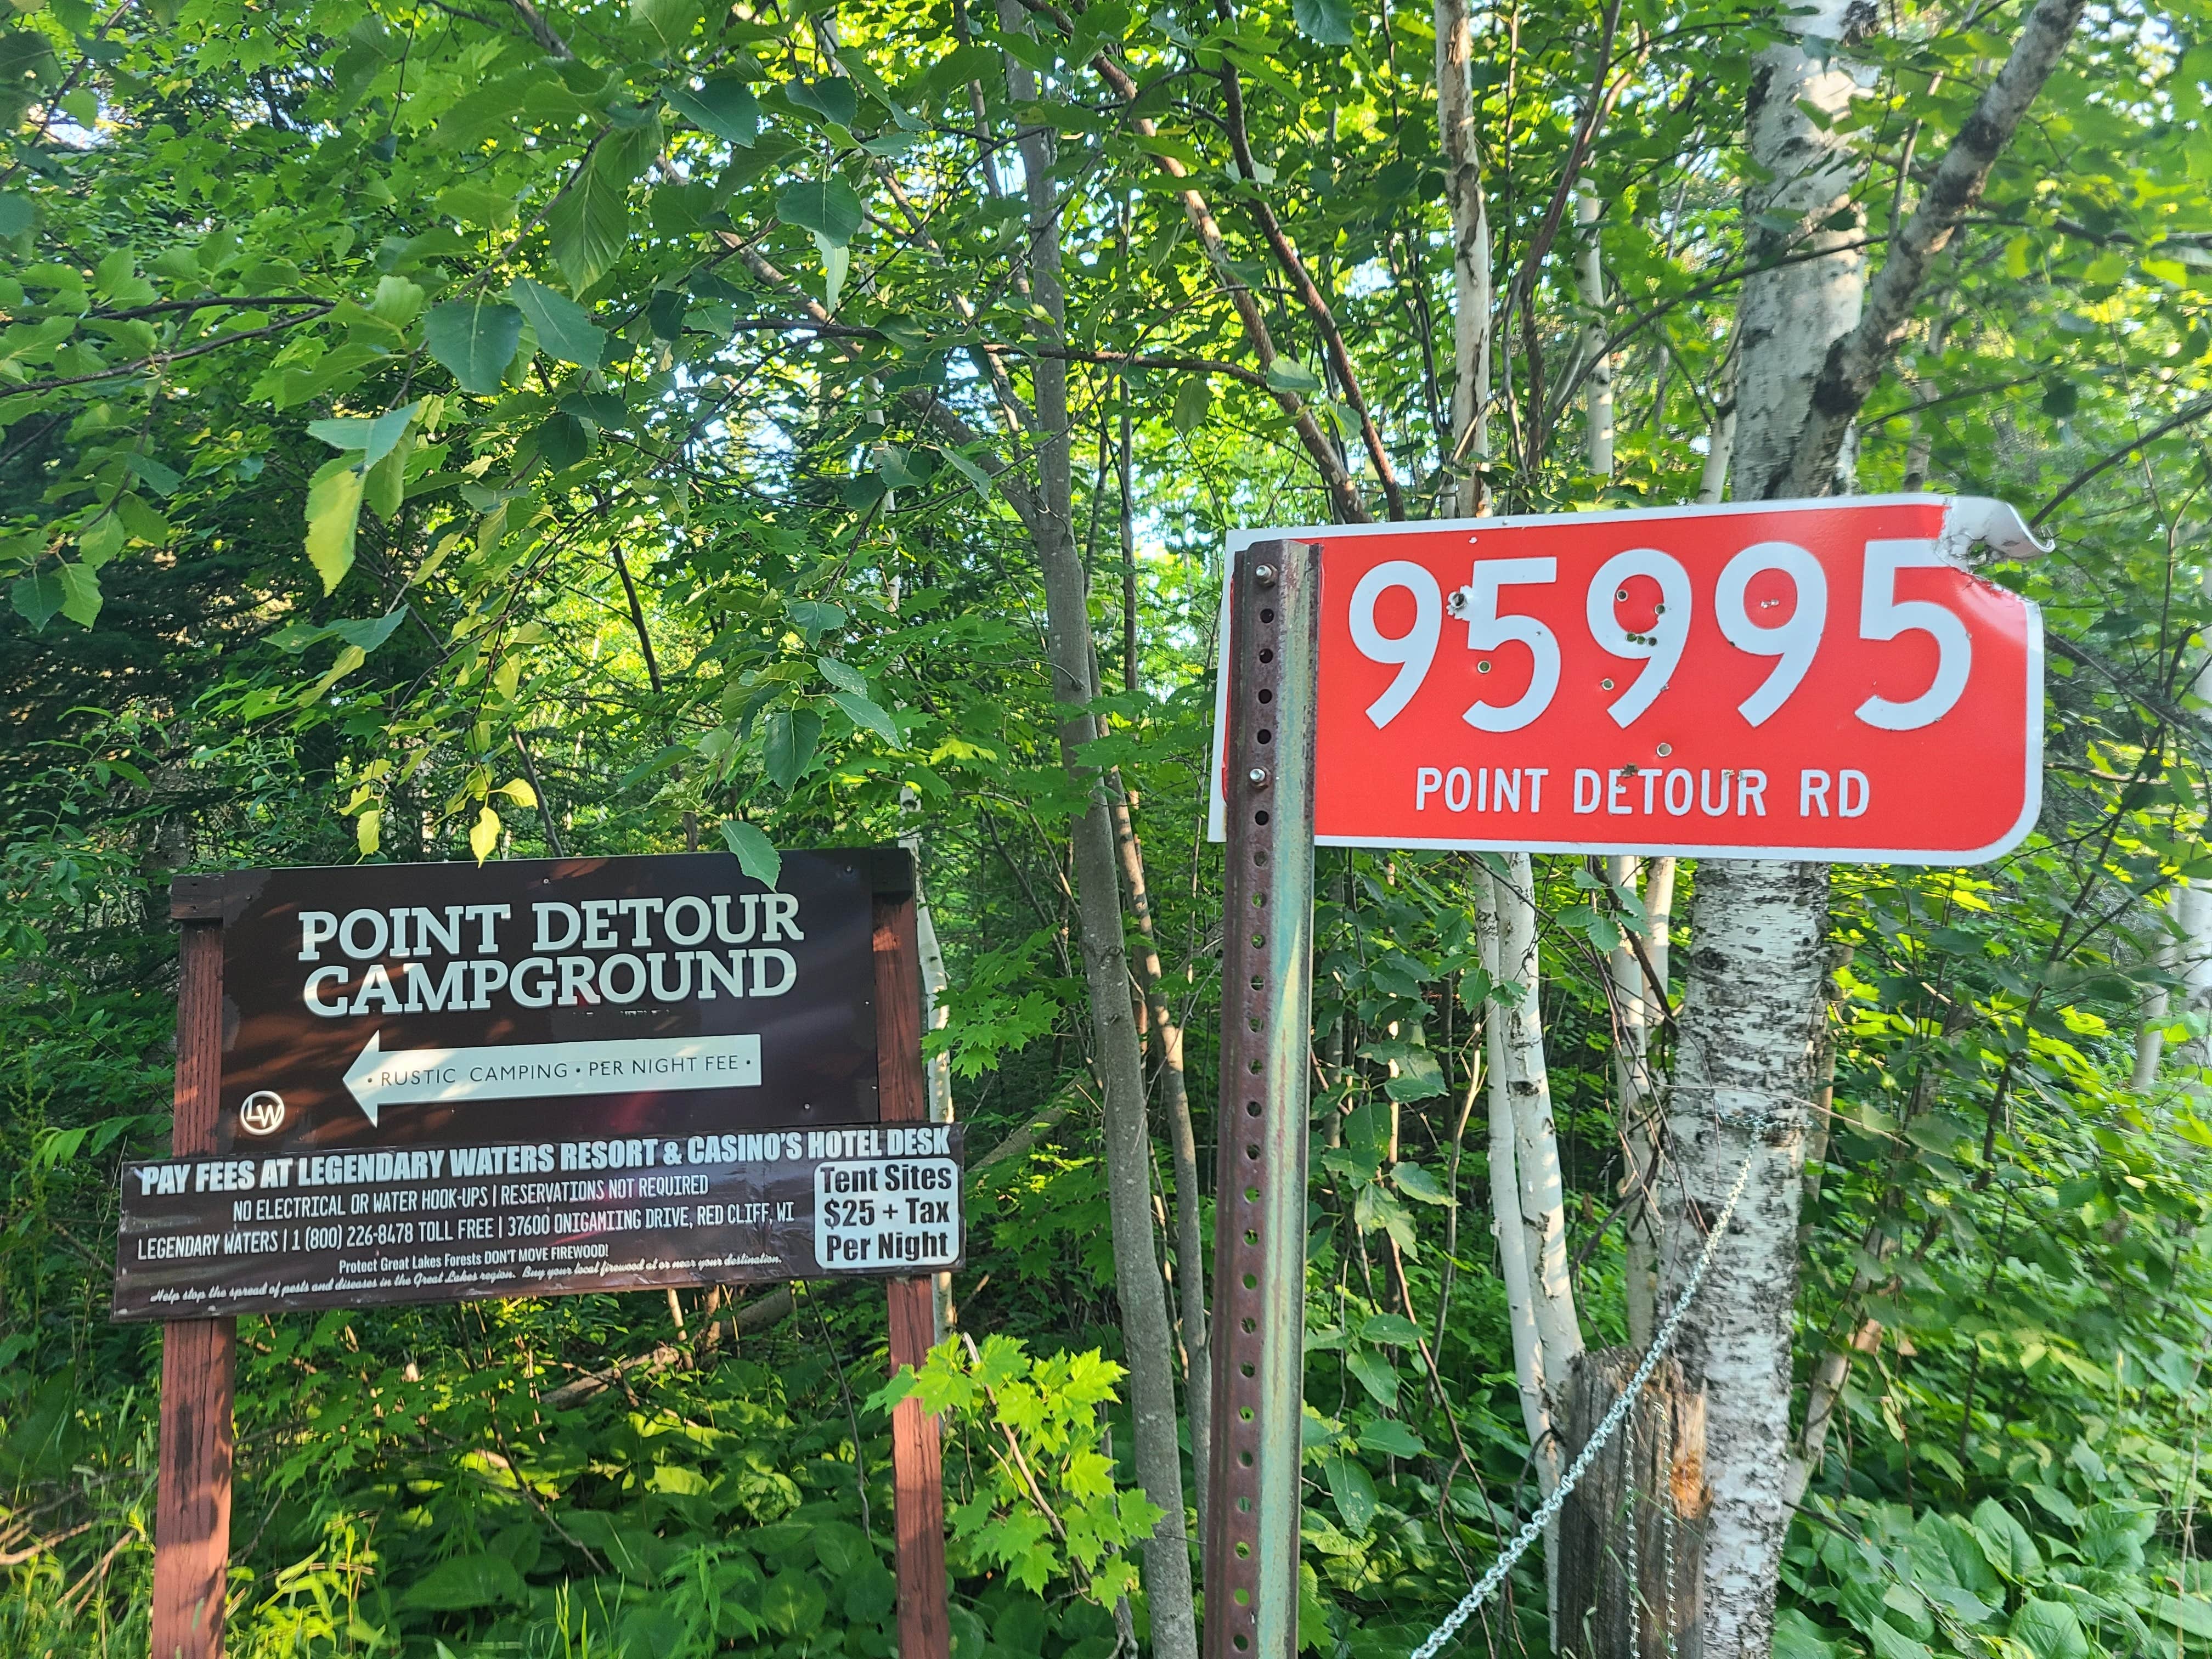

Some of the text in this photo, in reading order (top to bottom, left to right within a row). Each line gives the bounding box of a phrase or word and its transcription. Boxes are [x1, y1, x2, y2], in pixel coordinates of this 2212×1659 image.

[1348, 539, 1973, 733] 95995
[1416, 767, 1870, 818] POINT DETOUR RD
[298, 893, 805, 961] POINT DETOUR
[303, 948, 798, 1018] CAMPGROUND
[381, 1054, 740, 1087] RUSTIC CAMPING PER NIGHT FEE
[141, 1126, 951, 1196] PAY FEES AT LEGENDARY WATERS RESORT & CASINO'S HOTEL DESK
[820, 1164, 952, 1194] Tent Sites
[233, 1200, 252, 1222] NO
[256, 1194, 346, 1221] ELECTRICAL
[351, 1193, 369, 1215] OR
[373, 1190, 417, 1213] WATER
[421, 1186, 488, 1211] HOOK-UPS
[500, 1180, 605, 1206] RESERVATIONS
[608, 1178, 635, 1200] NOT
[639, 1174, 709, 1198] REQUIRED
[824, 1198, 875, 1230] $25
[905, 1197, 950, 1224] Tax
[138, 1233, 221, 1260] LEGENDARY
[224, 1229, 278, 1255] WATERS
[291, 1229, 301, 1251] 1
[305, 1224, 342, 1252] (800)
[346, 1222, 413, 1247] 226-8478
[418, 1220, 454, 1242] TOLL
[458, 1217, 495, 1240] FREE
[507, 1214, 550, 1236] 37600
[554, 1209, 642, 1234] ONIGAMIING
[645, 1206, 693, 1229] DRIVE,
[697, 1205, 724, 1226] RED
[727, 1202, 773, 1225] CLIFF,
[776, 1201, 795, 1222] WI
[826, 1232, 949, 1262] Per Night
[150, 1286, 180, 1305] Help
[182, 1286, 207, 1304] stop
[208, 1285, 227, 1299] the
[228, 1281, 268, 1301] spread
[268, 1280, 281, 1299] of
[281, 1279, 309, 1298] pests
[311, 1277, 335, 1292] and
[335, 1277, 377, 1290] diseases
[379, 1278, 392, 1288] in
[394, 1273, 411, 1286] the
[413, 1271, 444, 1288] Great
[444, 1269, 478, 1284] Lakes
[479, 1269, 516, 1284] region.
[522, 1265, 546, 1280] Buy
[546, 1267, 574, 1280] your
[574, 1261, 601, 1275] local
[599, 1257, 646, 1277] firewood
[646, 1257, 658, 1271] at
[658, 1260, 670, 1270] or
[672, 1258, 697, 1269] near
[697, 1257, 724, 1271] your
[338, 1243, 610, 1274] Protect Great Lakes Forests DON'T MOVE FIREWOOD!
